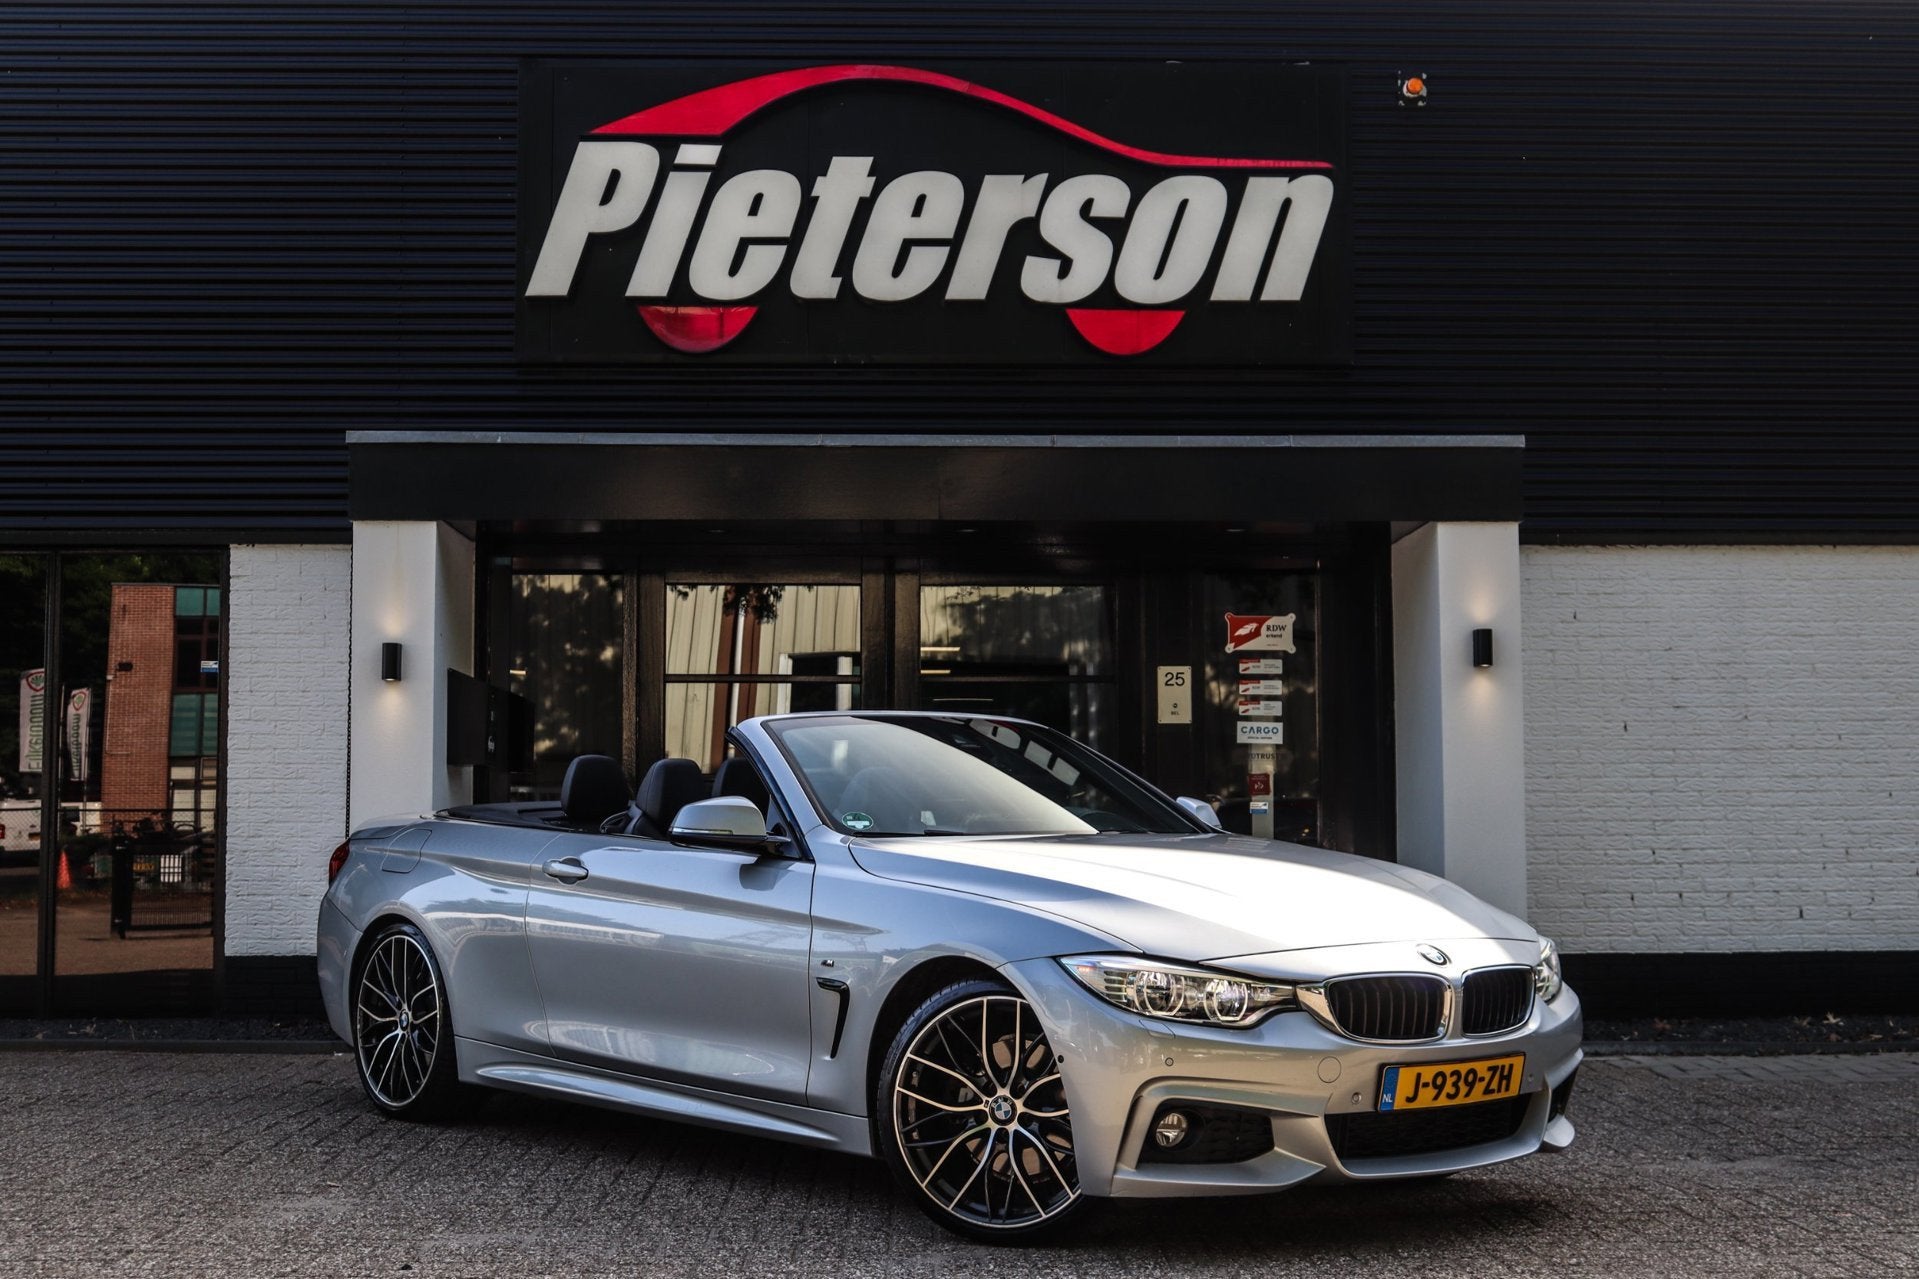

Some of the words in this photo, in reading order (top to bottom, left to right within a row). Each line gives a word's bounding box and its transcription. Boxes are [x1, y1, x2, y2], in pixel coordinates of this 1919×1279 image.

[524, 140, 1335, 305] Pieterson
[1266, 624, 1287, 632] RDW
[1164, 672, 1185, 687] 25
[1240, 726, 1280, 735] CARGO
[1405, 1063, 1514, 1103] J-939-ZH
[1382, 1093, 1393, 1103] NL
